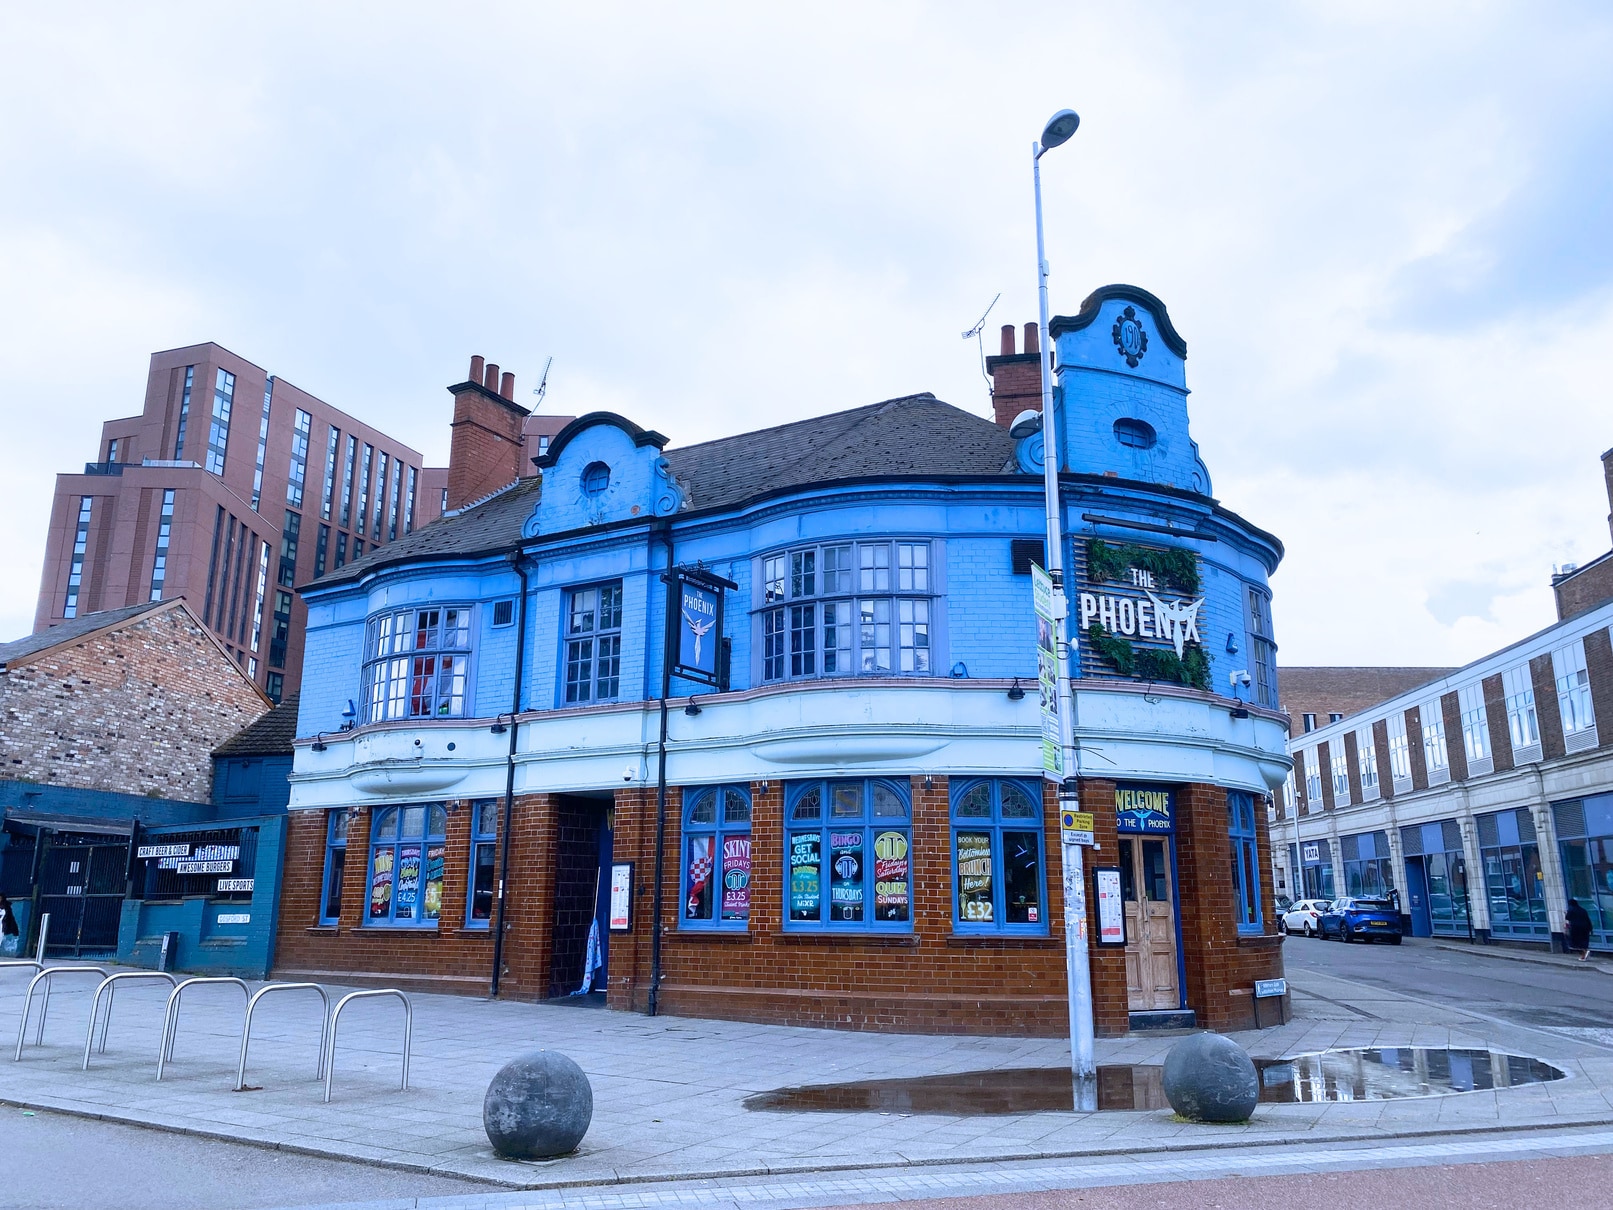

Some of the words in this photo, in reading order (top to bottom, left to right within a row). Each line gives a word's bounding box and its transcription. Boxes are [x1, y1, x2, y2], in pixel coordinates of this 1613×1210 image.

[1131, 568, 1155, 588] THE
[684, 594, 714, 617] PHOENIX
[1124, 818, 1136, 828] THE
[1148, 819, 1171, 829] PHOENIX
[831, 833, 862, 848] BINGO
[958, 836, 973, 844] BOOK
[974, 836, 989, 844] YOUR
[155, 846, 168, 856] BEER
[173, 845, 188, 855] CIDER
[724, 839, 751, 859] SKINT
[794, 843, 813, 854] GET
[957, 846, 991, 861] Bottomless
[1305, 847, 1319, 859] YATA
[724, 860, 750, 870] FRIDAYS
[791, 853, 820, 865] SOCIAL
[180, 862, 205, 873] AWESOME
[206, 861, 230, 872] BURGERS
[842, 860, 852, 879] DJ
[876, 866, 908, 879] Saturdays
[959, 858, 992, 876] BRUNCH
[219, 880, 231, 890] LIVE
[232, 880, 254, 890] SPORTS
[792, 880, 819, 893] £3.25
[876, 881, 907, 896] QUIZ
[964, 876, 990, 890] Here!
[397, 892, 416, 903] £4.25
[726, 891, 746, 901] £3.25
[832, 887, 863, 901] THURSDAYS
[877, 894, 908, 904] SUNDAYS
[967, 901, 993, 919] £32
